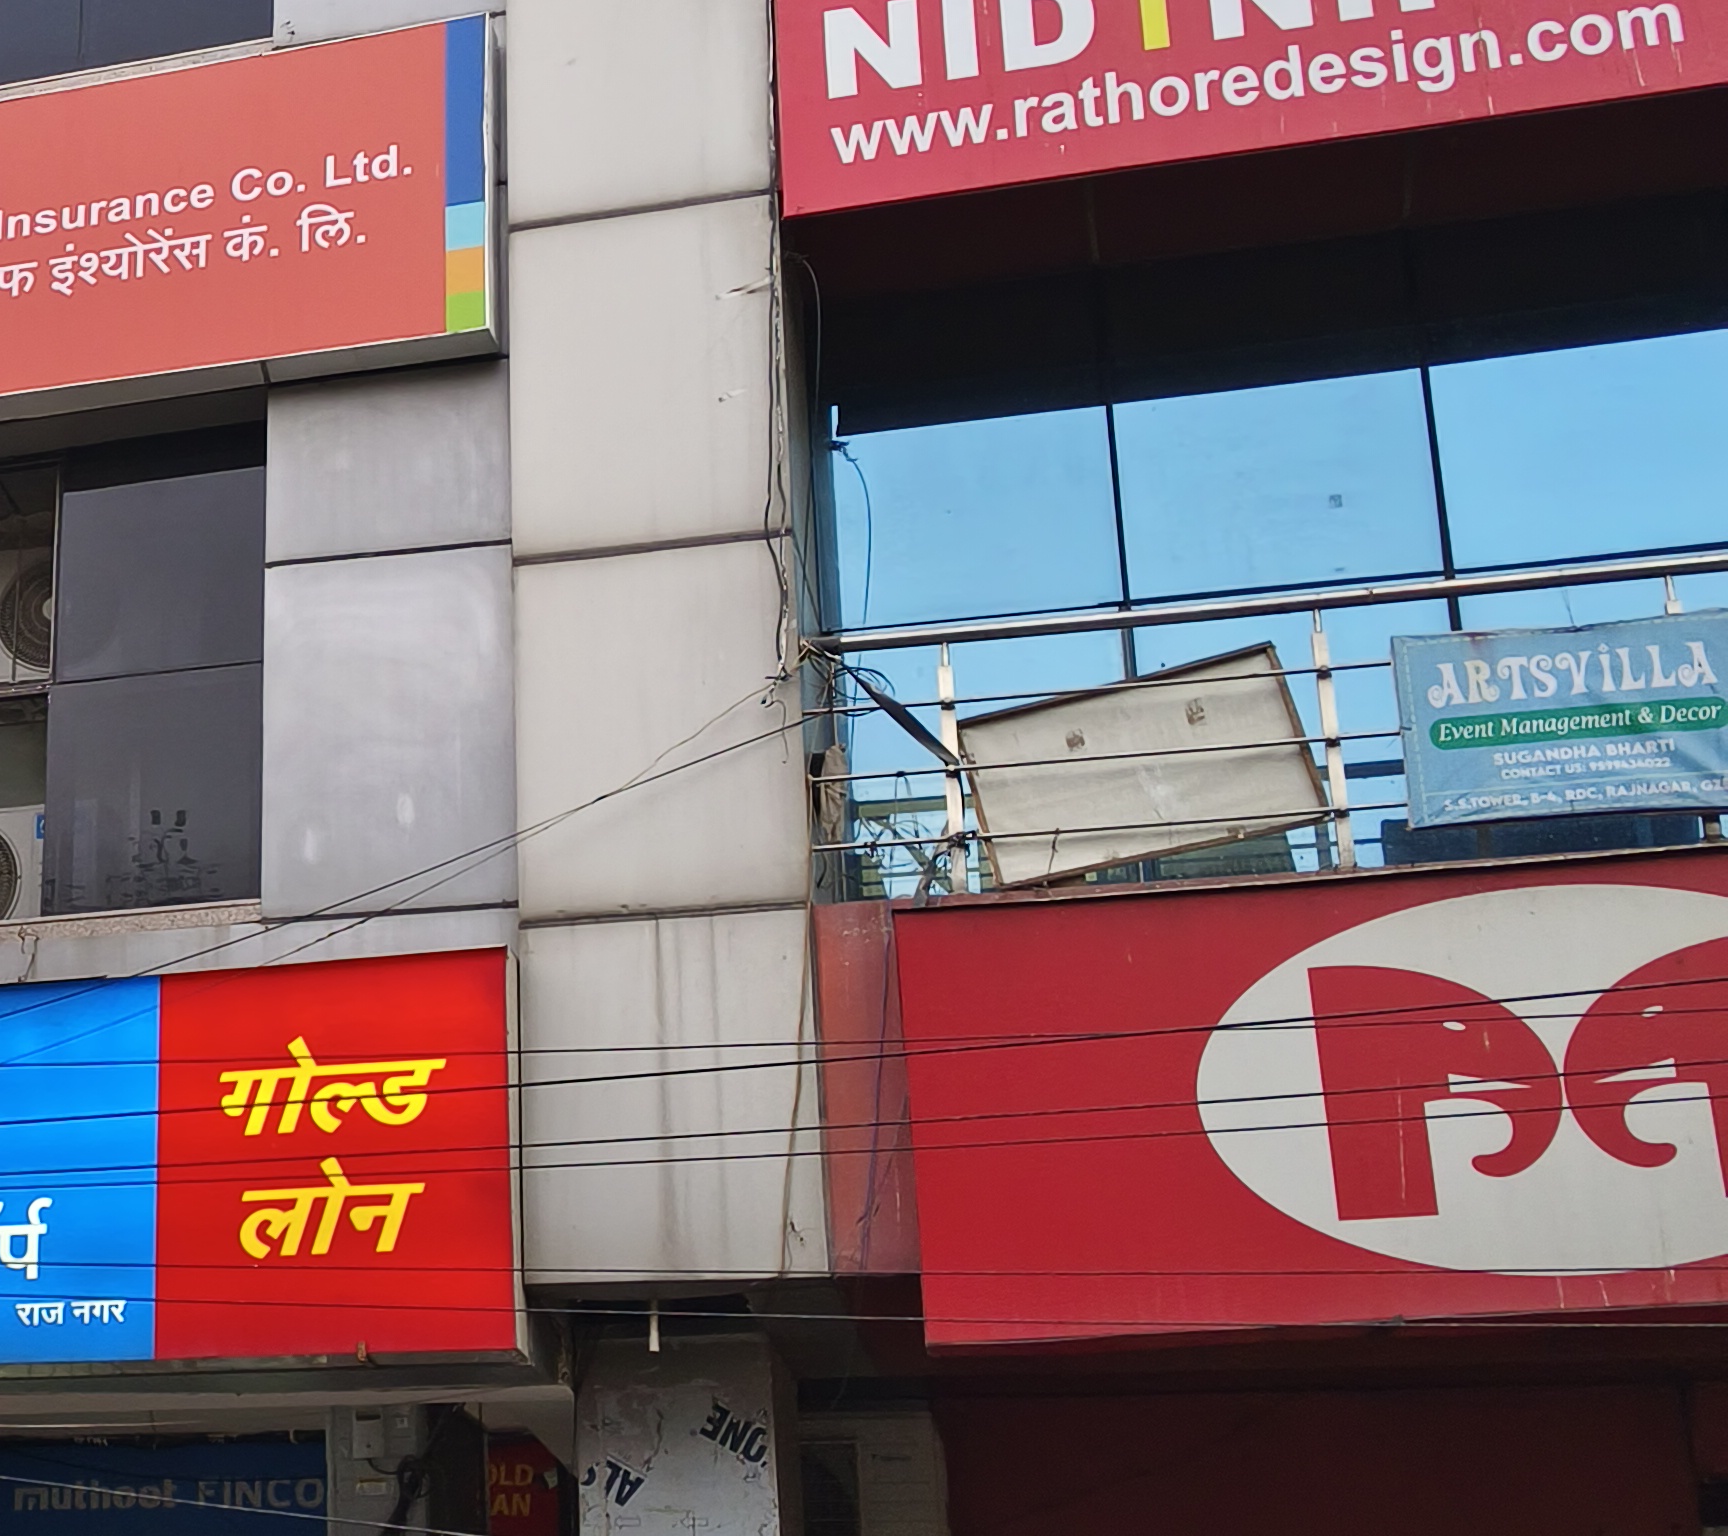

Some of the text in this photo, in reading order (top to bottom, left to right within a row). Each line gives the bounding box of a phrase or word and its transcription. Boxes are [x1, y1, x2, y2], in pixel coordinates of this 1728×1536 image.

[829, 1, 1685, 165] www.rathoredesign.com
[230, 163, 308, 203] Co.
[323, 143, 416, 187] Ltd.
[47, 222, 209, 298] इंश्योरेंस
[296, 203, 369, 252] लि.
[1438, 700, 1723, 743] Event Management & Decor
[1492, 737, 1677, 766] SUGANDHA BHARTI
[218, 1035, 448, 1139] गोल्ड
[236, 1157, 426, 1262] लोन
[15, 1296, 127, 1328] राज नगर
[13, 1476, 178, 1512] muthoot
